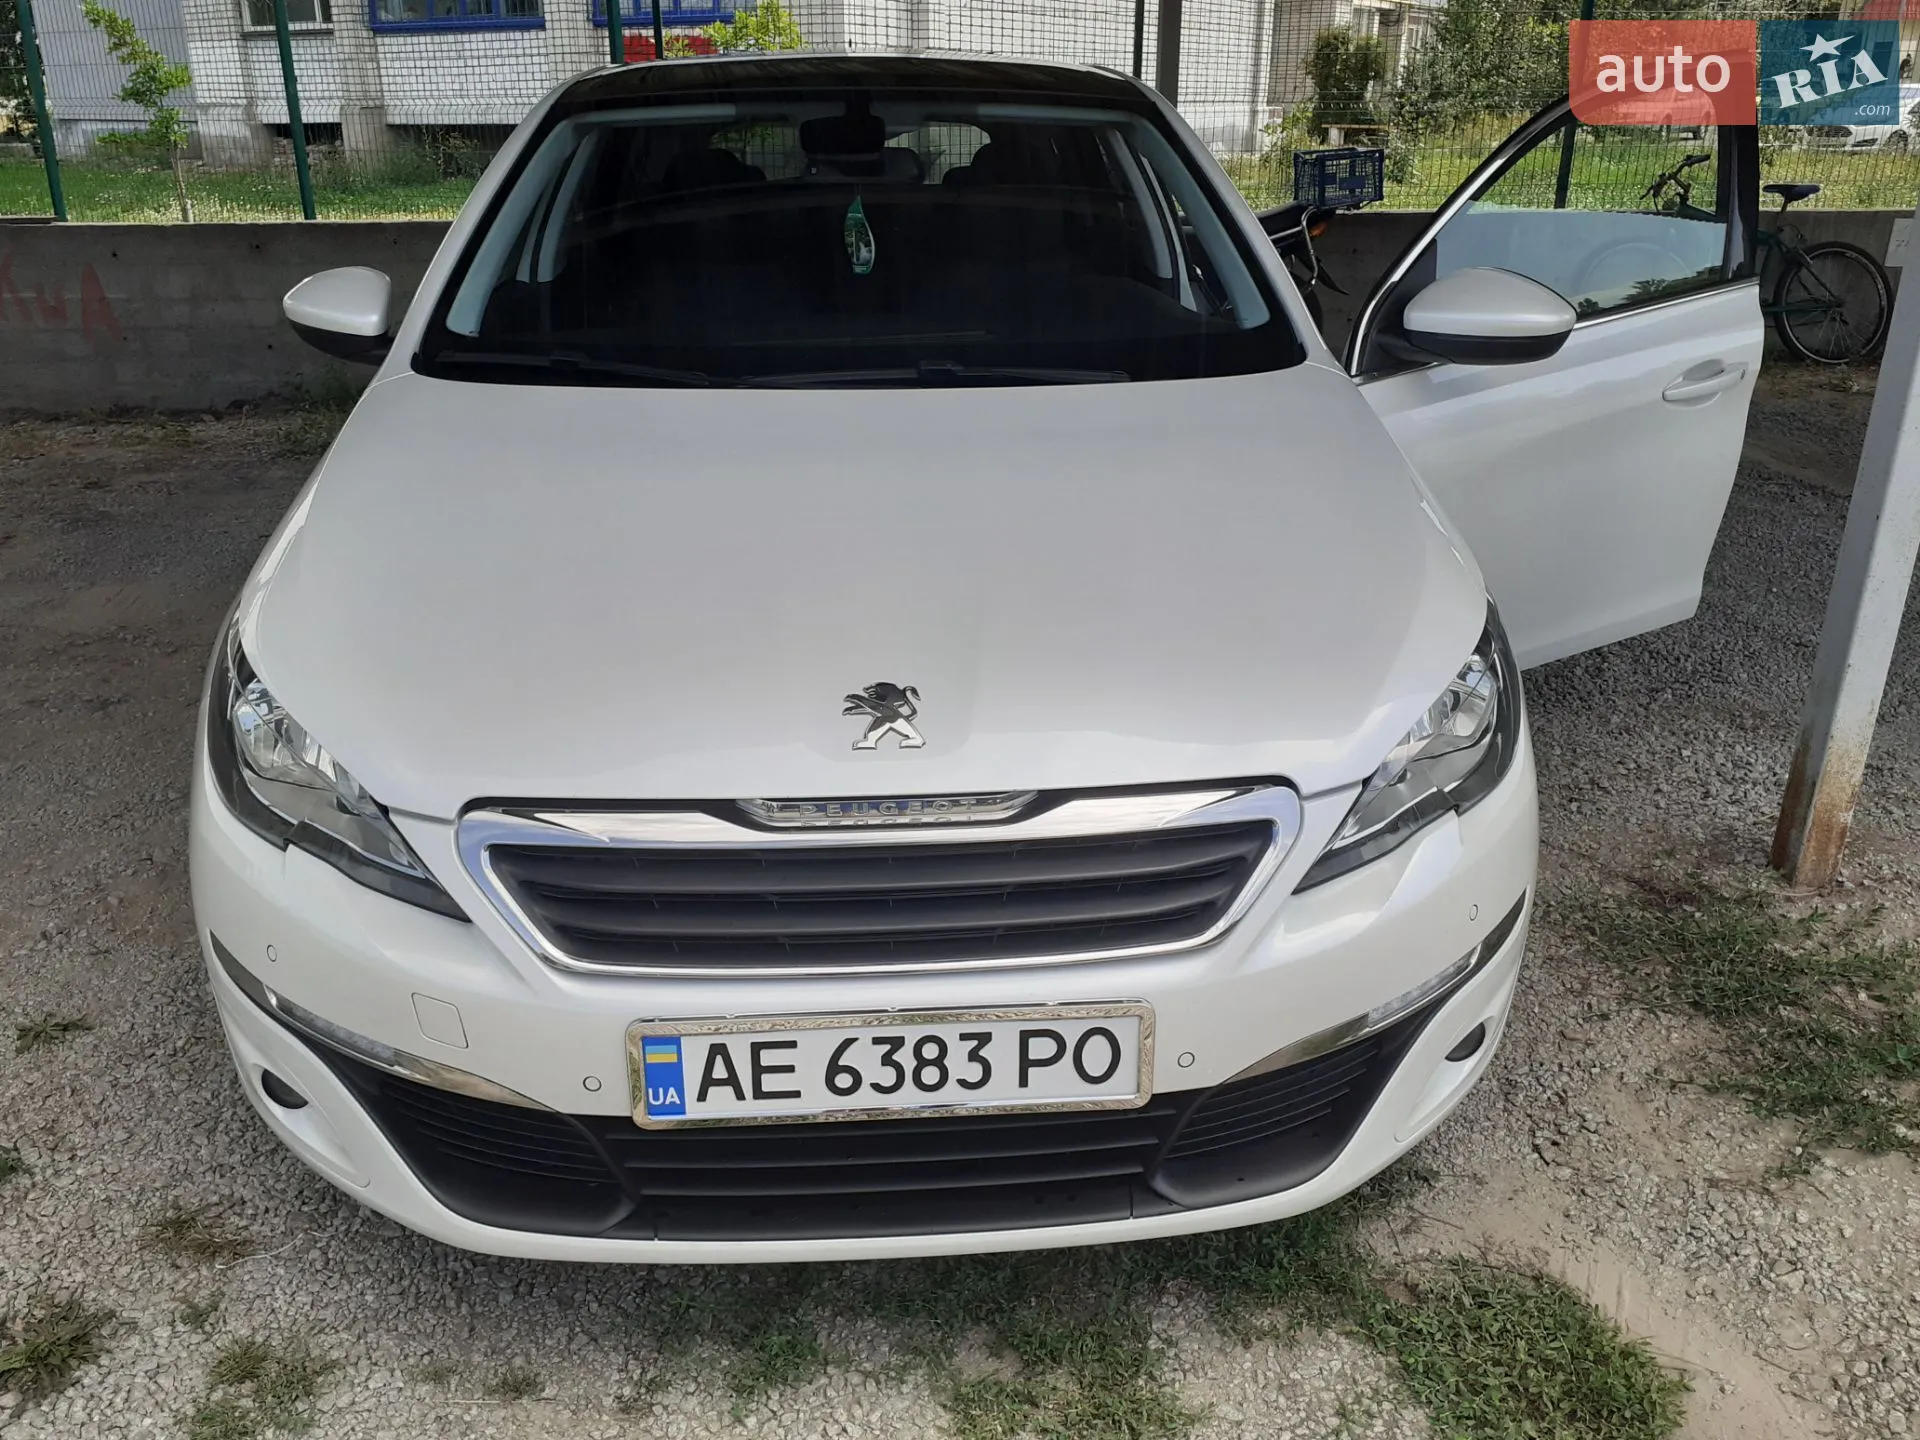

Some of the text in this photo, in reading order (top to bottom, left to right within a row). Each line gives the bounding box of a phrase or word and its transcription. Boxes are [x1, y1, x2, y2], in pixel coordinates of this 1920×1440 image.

[800, 798, 977, 816] PEUGEOT
[696, 1026, 1122, 1102] AE 6383 PO
[648, 1086, 681, 1105] UA
